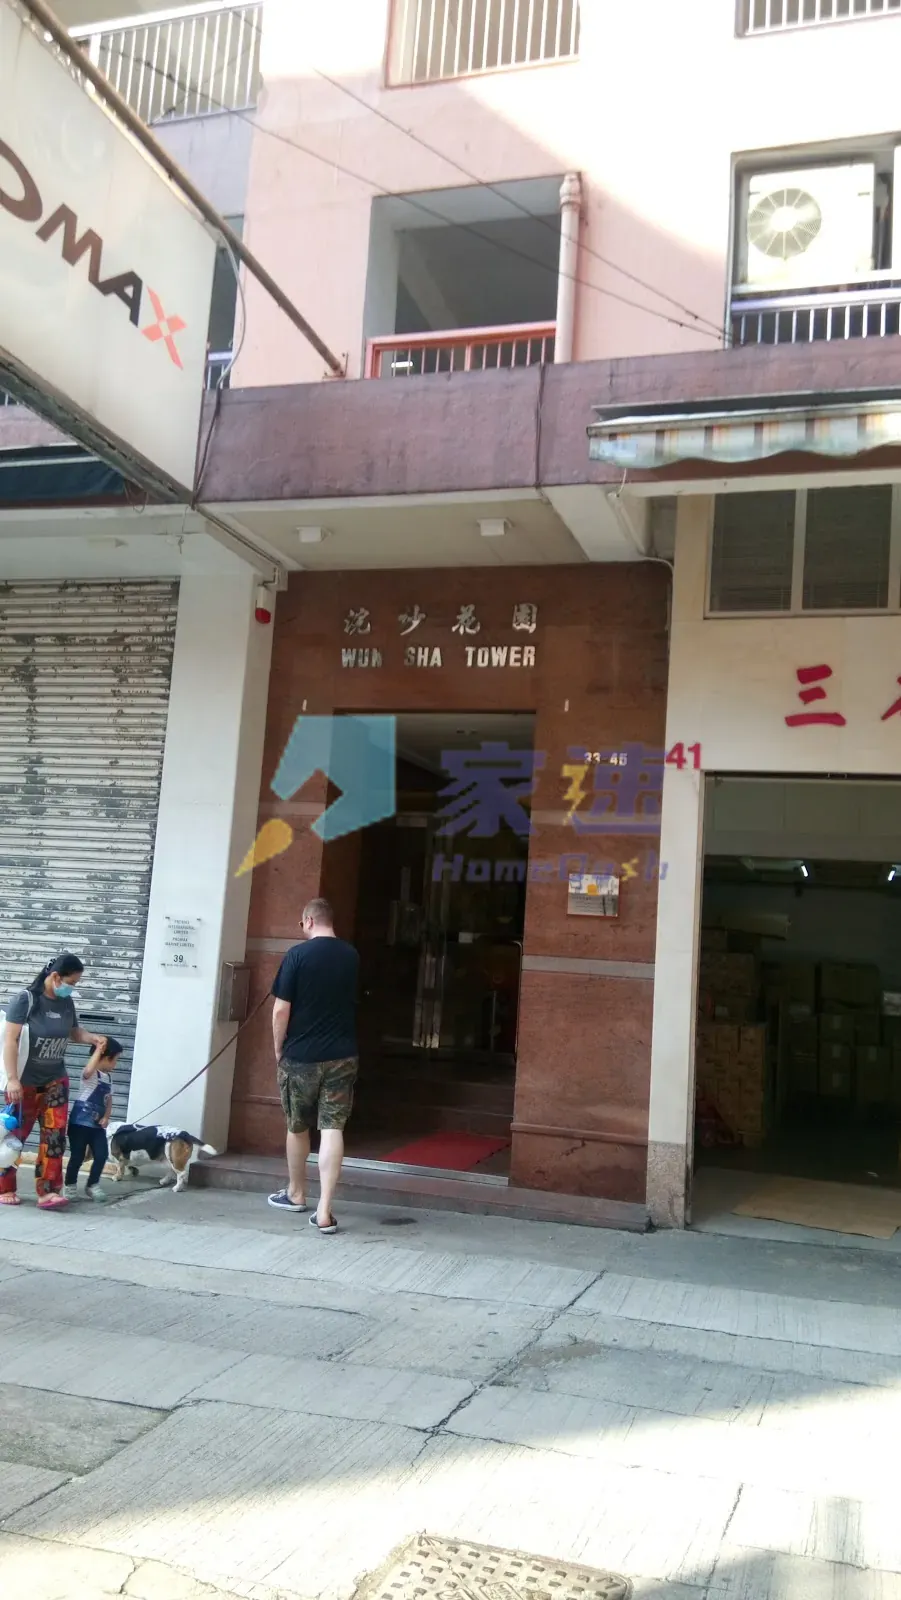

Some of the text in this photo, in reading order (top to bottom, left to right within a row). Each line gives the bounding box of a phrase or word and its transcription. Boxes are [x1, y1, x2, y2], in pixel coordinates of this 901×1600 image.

[341, 645, 535, 668] WUN SHA TOWER
[666, 742, 702, 769] 41
[173, 954, 184, 963] 39
